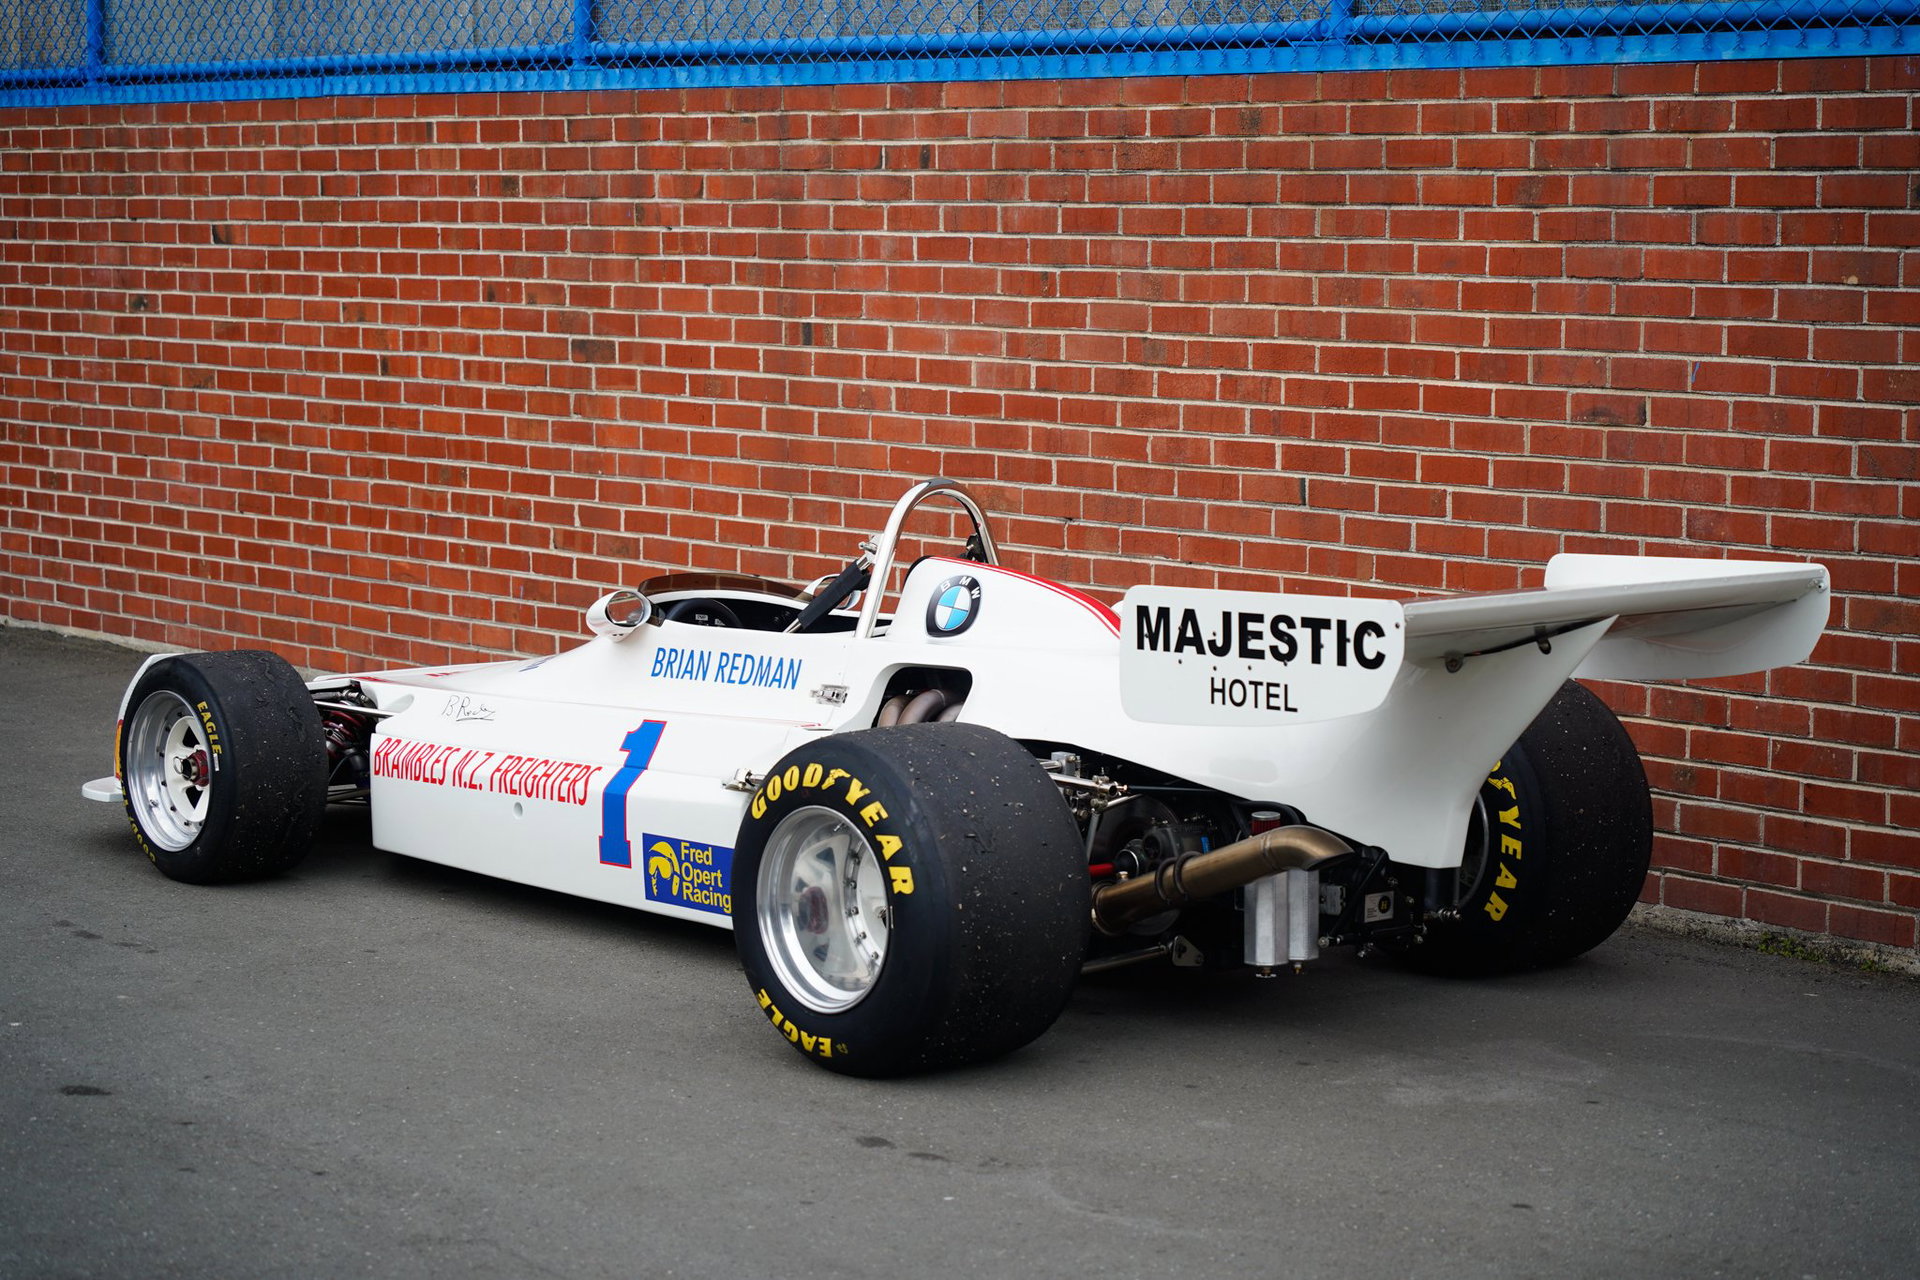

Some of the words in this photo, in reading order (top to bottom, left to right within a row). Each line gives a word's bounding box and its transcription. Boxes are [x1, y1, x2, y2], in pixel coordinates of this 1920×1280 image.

[940, 576, 981, 599] BMW
[1136, 604, 1387, 670] MAJESTIC
[650, 647, 712, 681] BRIAN
[714, 651, 803, 690] REDMAN
[1210, 676, 1299, 713] HOTEL
[197, 701, 223, 755] EAGLE
[373, 737, 461, 785] BRAMBLES
[453, 749, 495, 791] N.Z.
[490, 754, 603, 806] FREIGHTERS
[599, 719, 671, 870] 1
[680, 842, 713, 866] Fred
[751, 762, 916, 896] GOODYEAR
[1484, 760, 1523, 922] YEAR
[681, 862, 724, 888] Opert
[682, 882, 733, 915] Racing
[757, 988, 833, 1058] EAGLE
